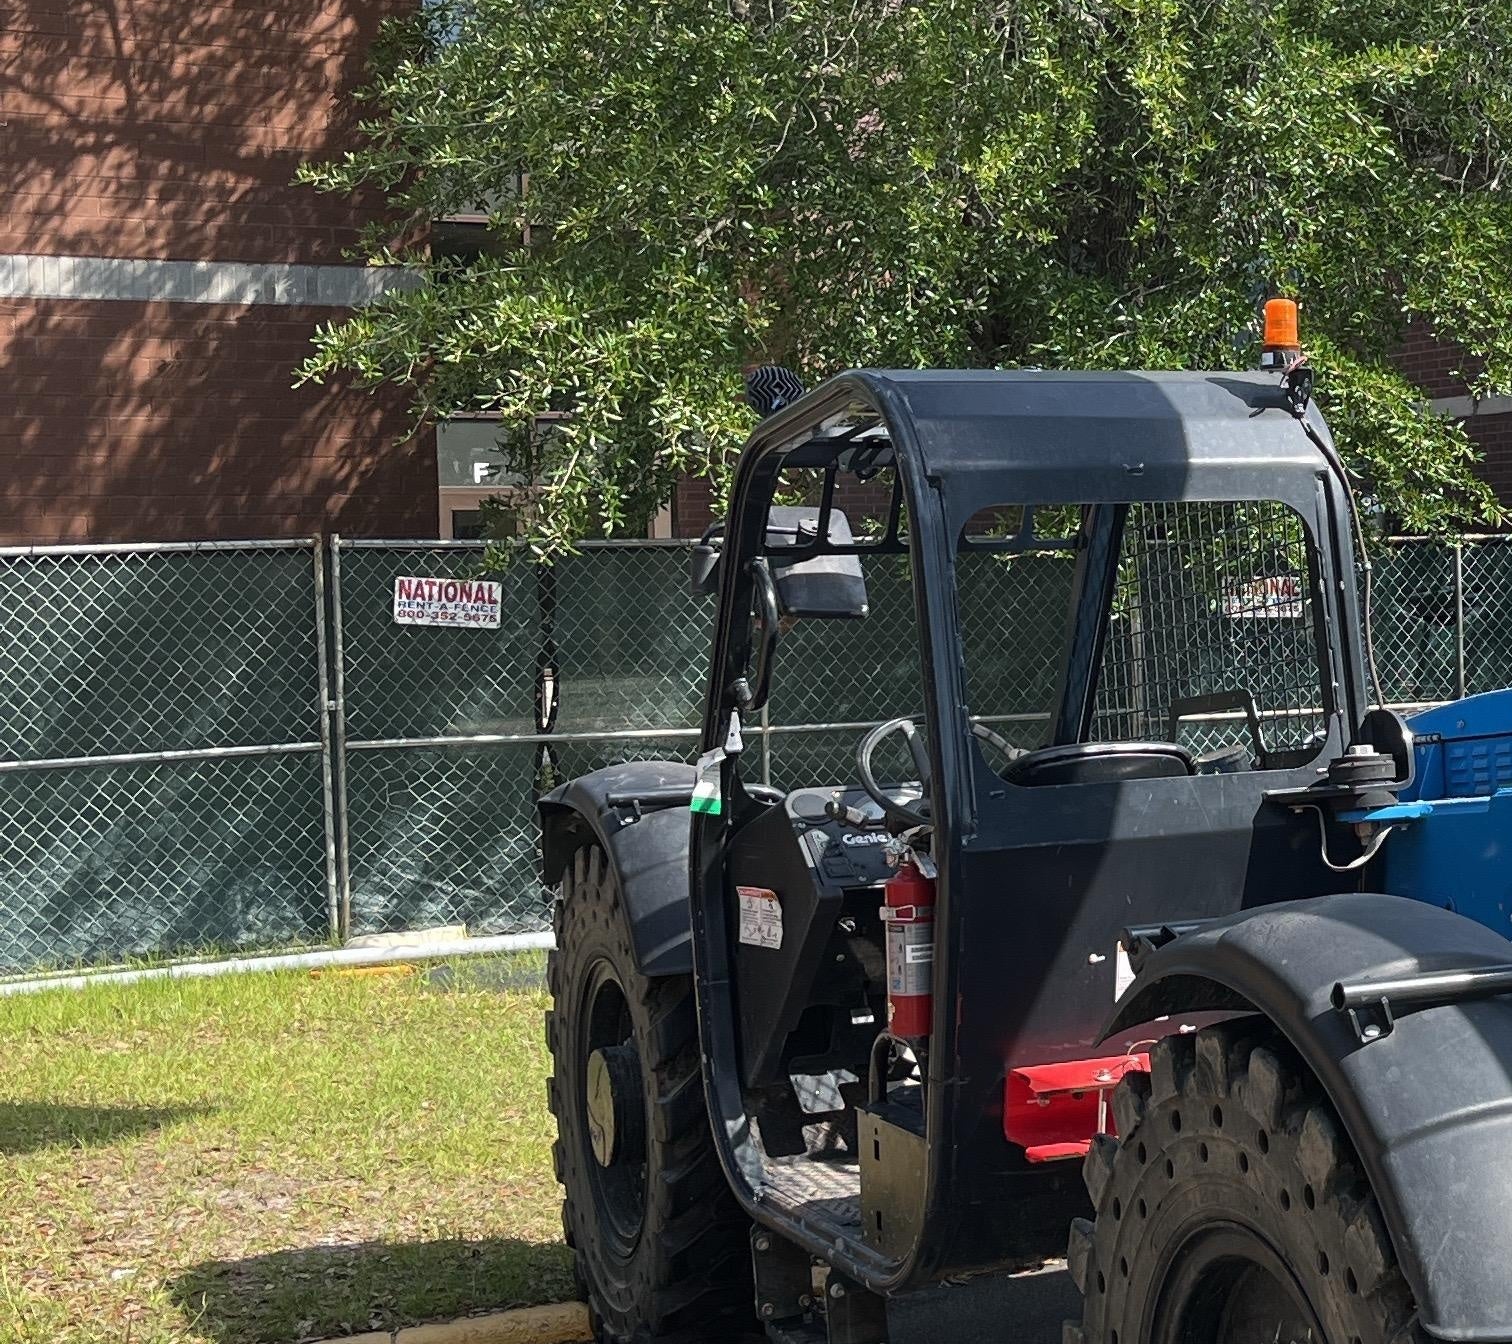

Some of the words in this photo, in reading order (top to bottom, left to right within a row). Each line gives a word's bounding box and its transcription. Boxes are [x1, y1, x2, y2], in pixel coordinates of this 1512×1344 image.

[399, 579, 498, 604] NATIONAL
[398, 601, 498, 613] RENT-A-FENCE
[842, 832, 888, 844] Genie
